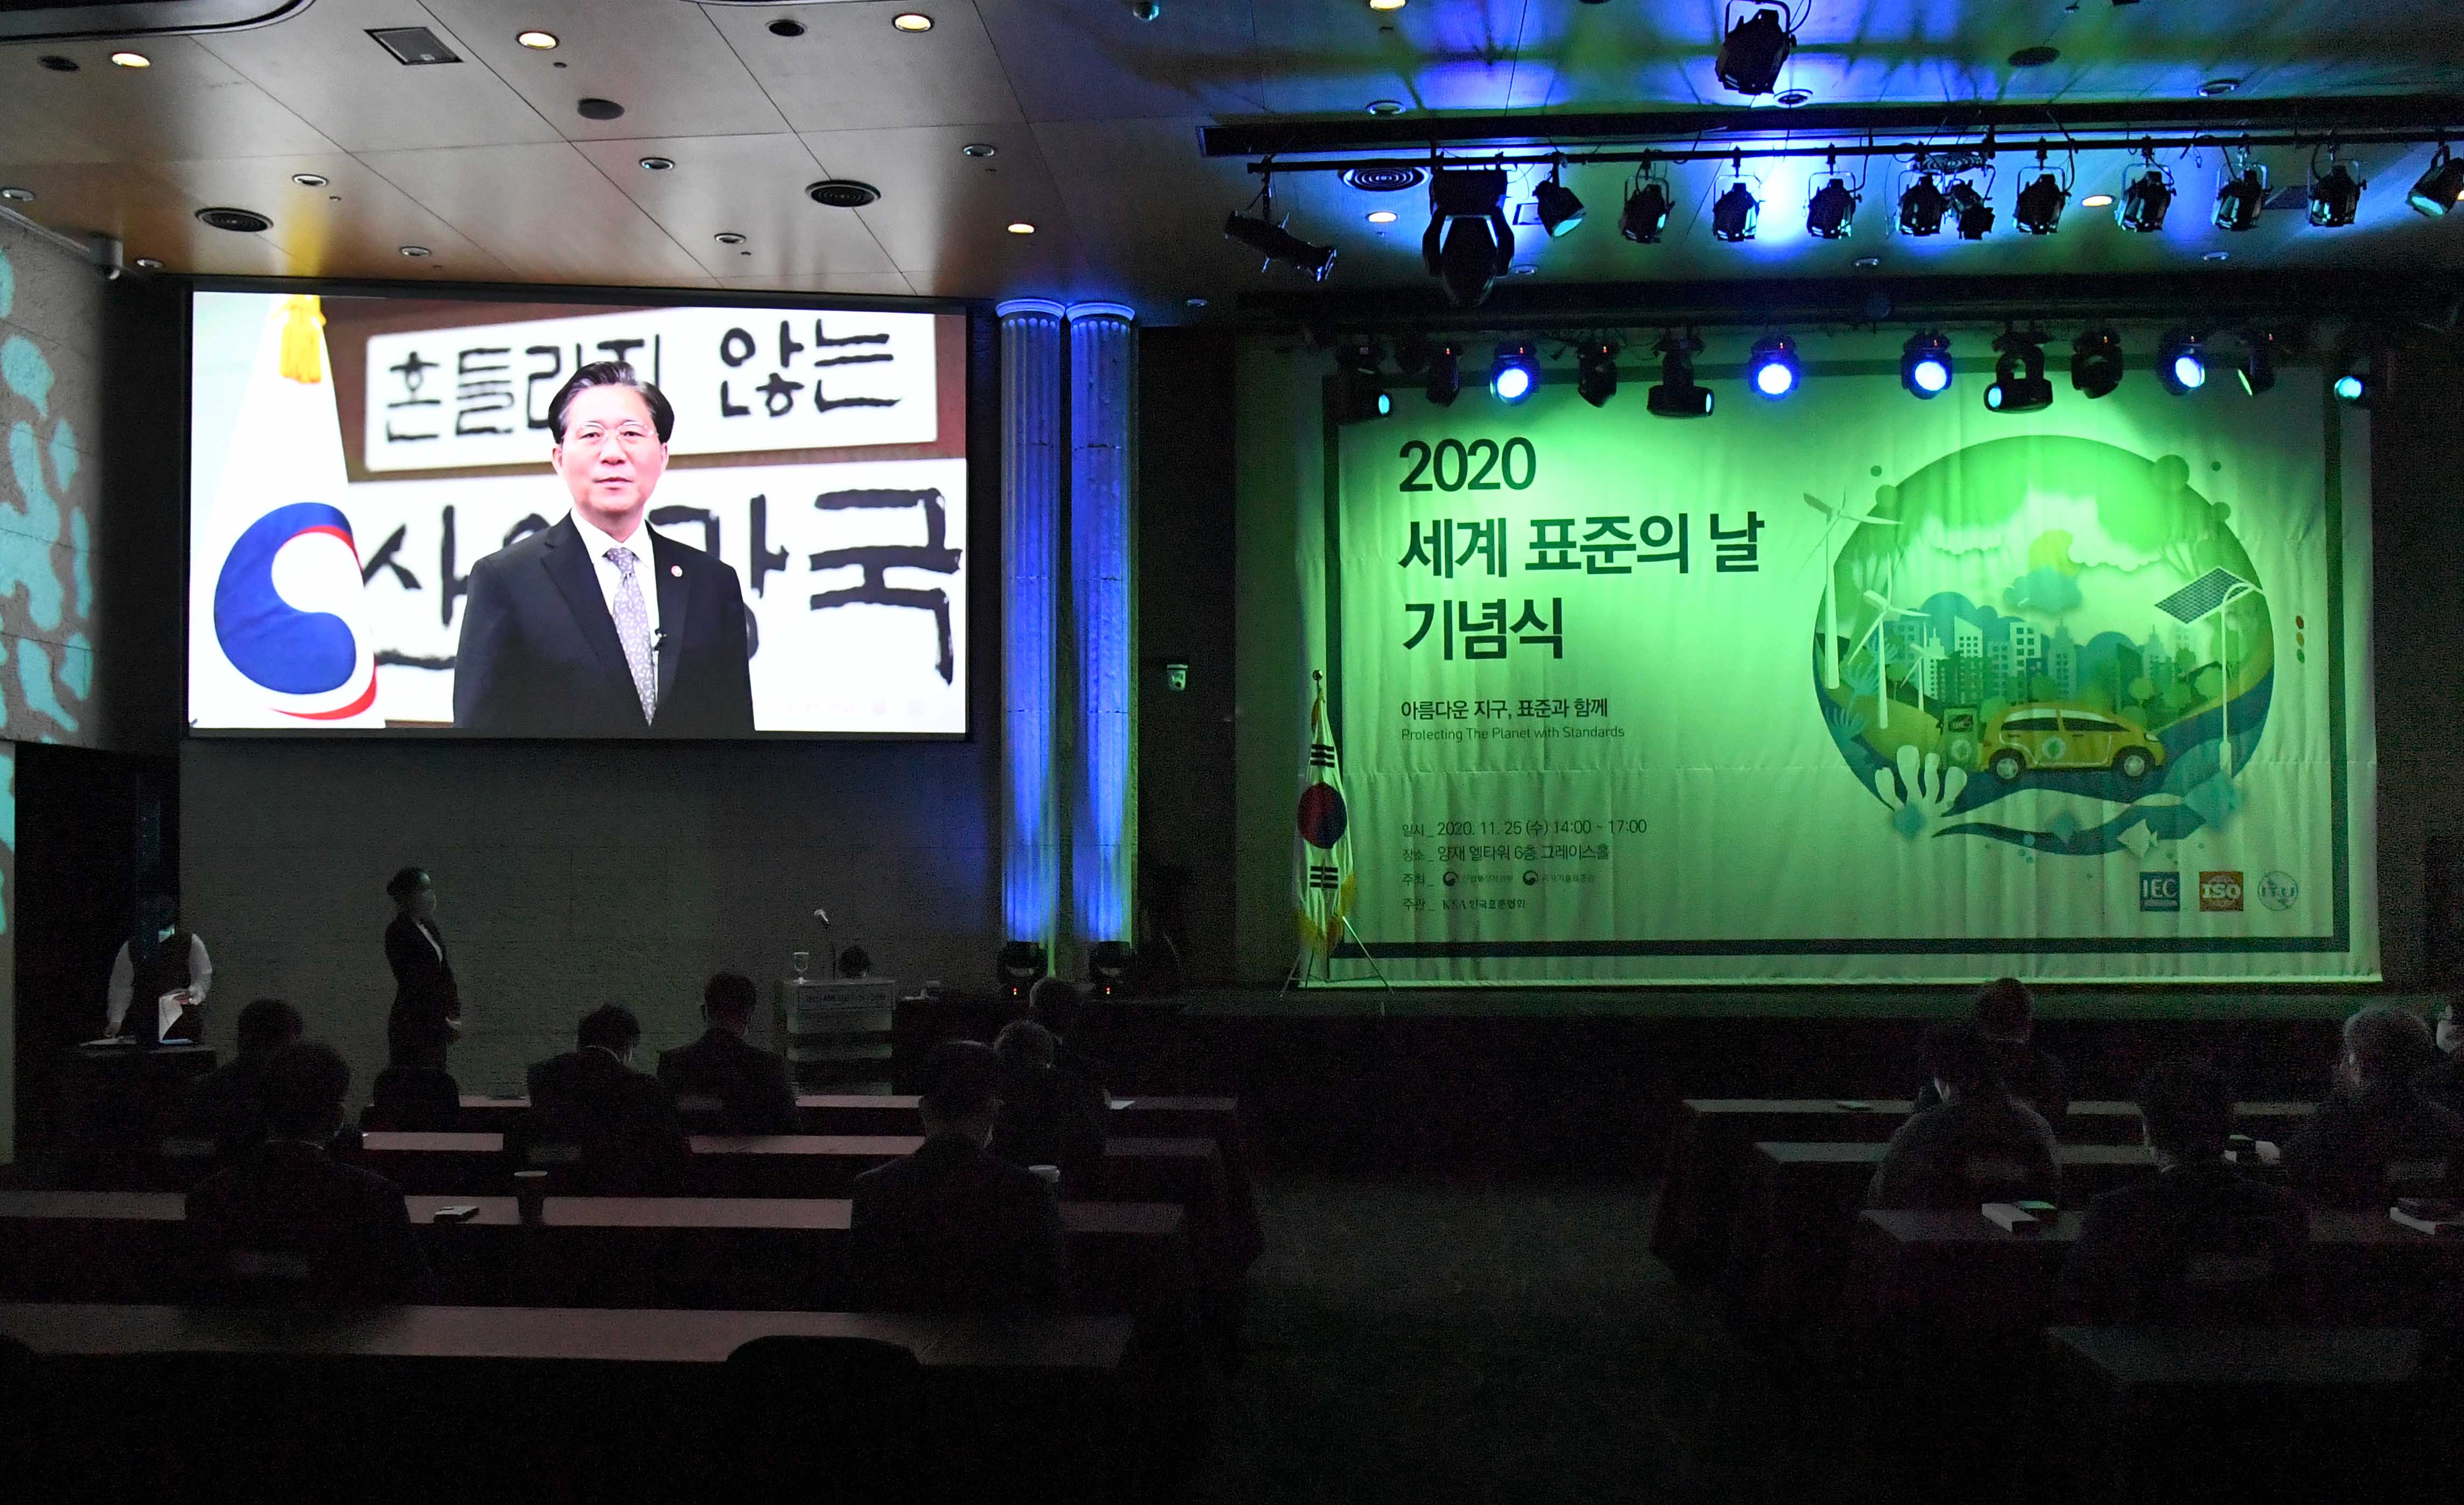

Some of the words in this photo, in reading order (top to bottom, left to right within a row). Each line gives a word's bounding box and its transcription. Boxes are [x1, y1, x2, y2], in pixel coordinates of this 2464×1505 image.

[720, 318, 903, 418] 않는
[1399, 437, 1537, 492] 2020
[1398, 517, 1507, 579] 세계
[1525, 513, 1688, 574] 표준의
[1710, 511, 1765, 572] 날
[1403, 597, 1563, 660] 기념식
[1401, 700, 1469, 720] 아름다운
[1474, 699, 1511, 719] 지구,
[1517, 698, 1569, 718] 표준과
[1574, 698, 1608, 717] 함께
[1402, 728, 1462, 743] Protecting
[1466, 728, 1488, 740] The
[1492, 727, 1530, 740] Planet
[1534, 726, 1559, 738] with
[1563, 725, 1624, 738] Standards
[1402, 824, 1424, 837] 일시
[1438, 821, 1475, 835] 2020.
[1481, 821, 1500, 835] 11.
[1554, 820, 1591, 834] 14:00
[1610, 819, 1647, 834] 17:00
[1438, 845, 1465, 861] 양재
[1469, 845, 1510, 861] 엘타워
[1514, 845, 1536, 861] 6층
[1541, 843, 1608, 860] 그레이스홀
[2142, 878, 2176, 899] IEC
[2202, 883, 2242, 899] ISO
